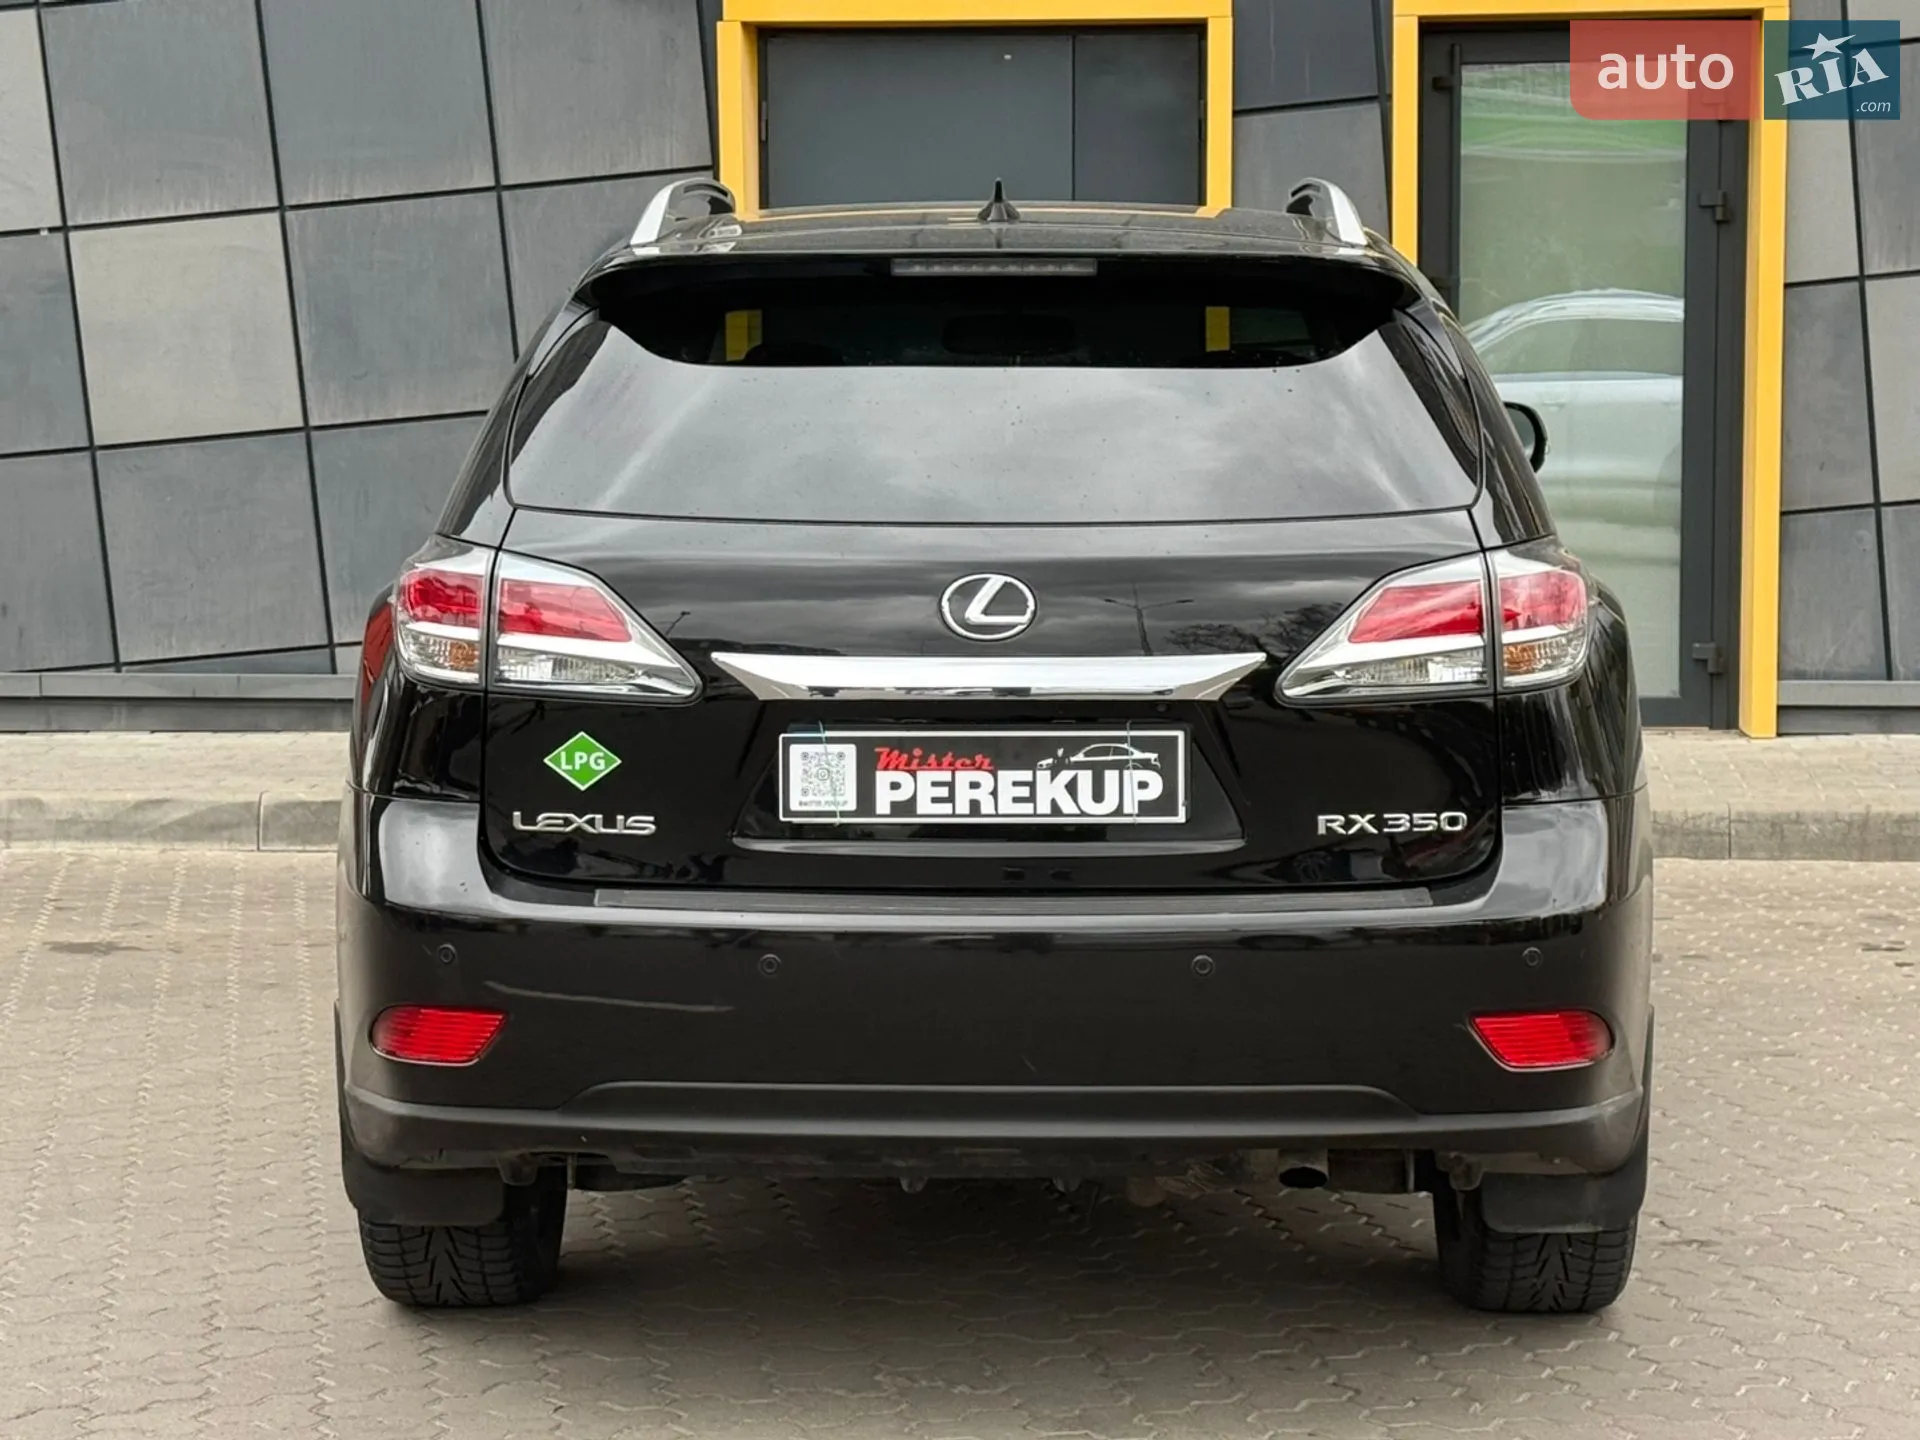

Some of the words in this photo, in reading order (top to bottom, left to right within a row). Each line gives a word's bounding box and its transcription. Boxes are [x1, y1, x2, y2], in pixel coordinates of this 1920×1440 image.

[559, 751, 606, 771] LPG
[874, 746, 995, 771] Mister
[875, 770, 1164, 816] PEREKUP
[512, 811, 657, 836] LEXUS
[1316, 813, 1379, 836] RX
[1382, 811, 1468, 833] 350
